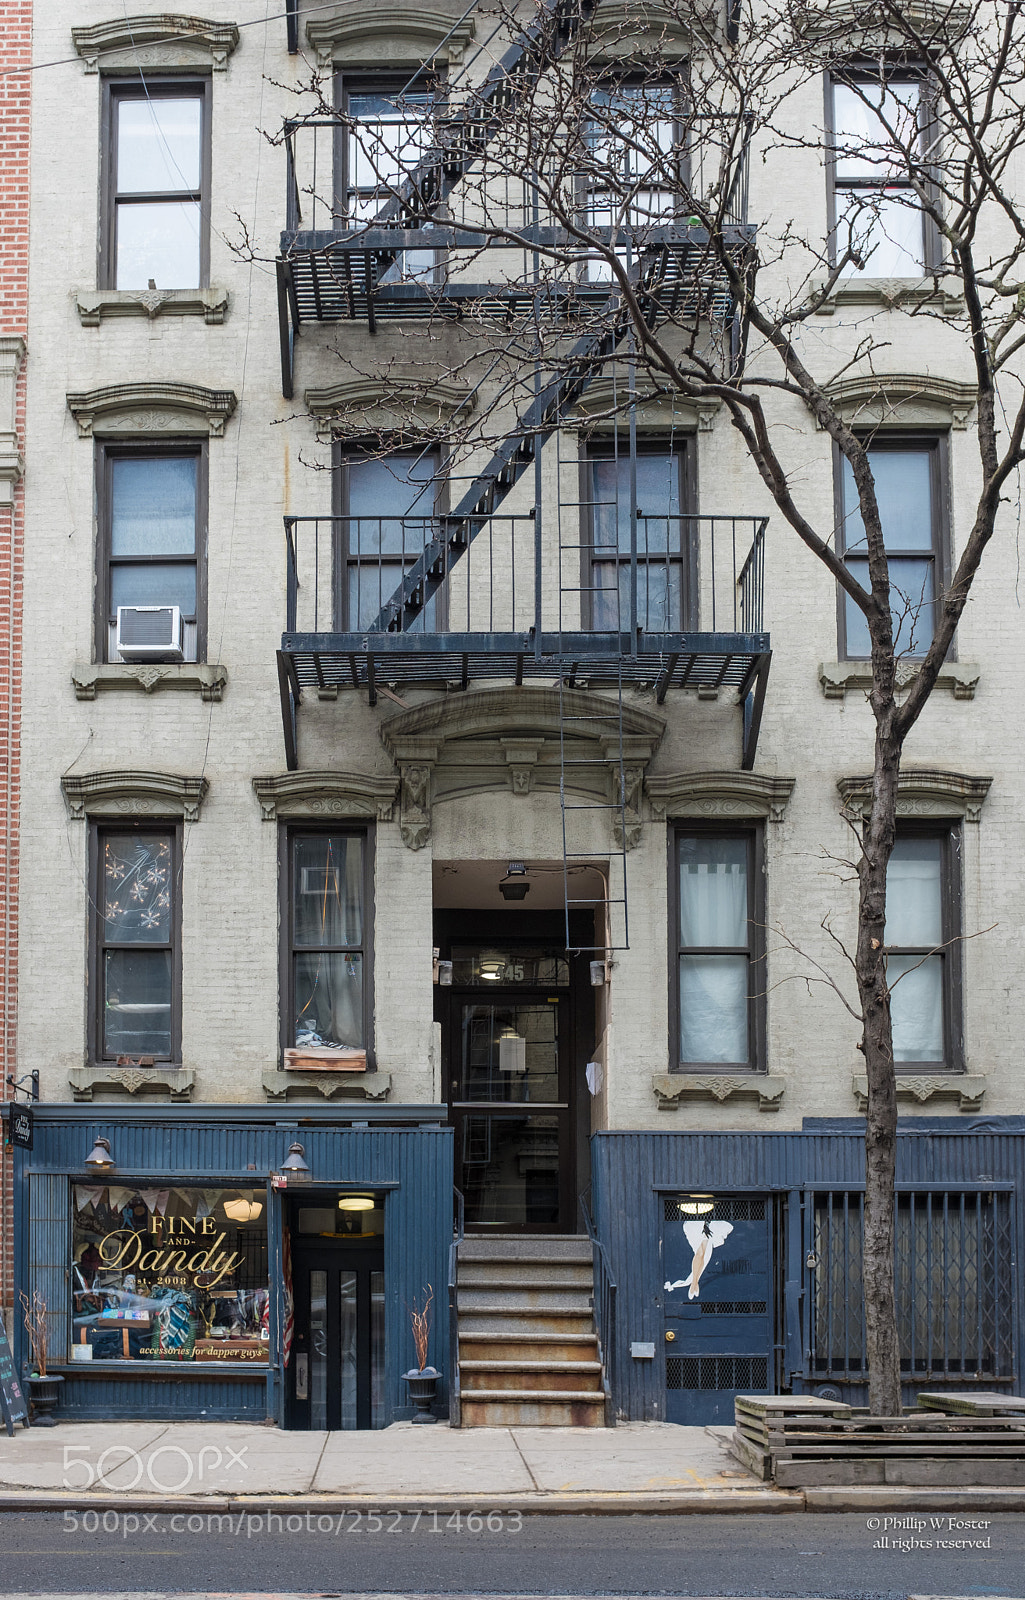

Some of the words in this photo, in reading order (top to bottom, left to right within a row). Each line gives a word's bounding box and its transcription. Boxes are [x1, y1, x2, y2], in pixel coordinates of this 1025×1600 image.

[150, 1215, 217, 1235] FINE
[98, 1228, 246, 1289] Dandy
[157, 1276, 187, 1285] 2008
[139, 1346, 190, 1355] accessories
[190, 1345, 208, 1358] for
[207, 1345, 240, 1359] dapper
[240, 1348, 263, 1359] guys
